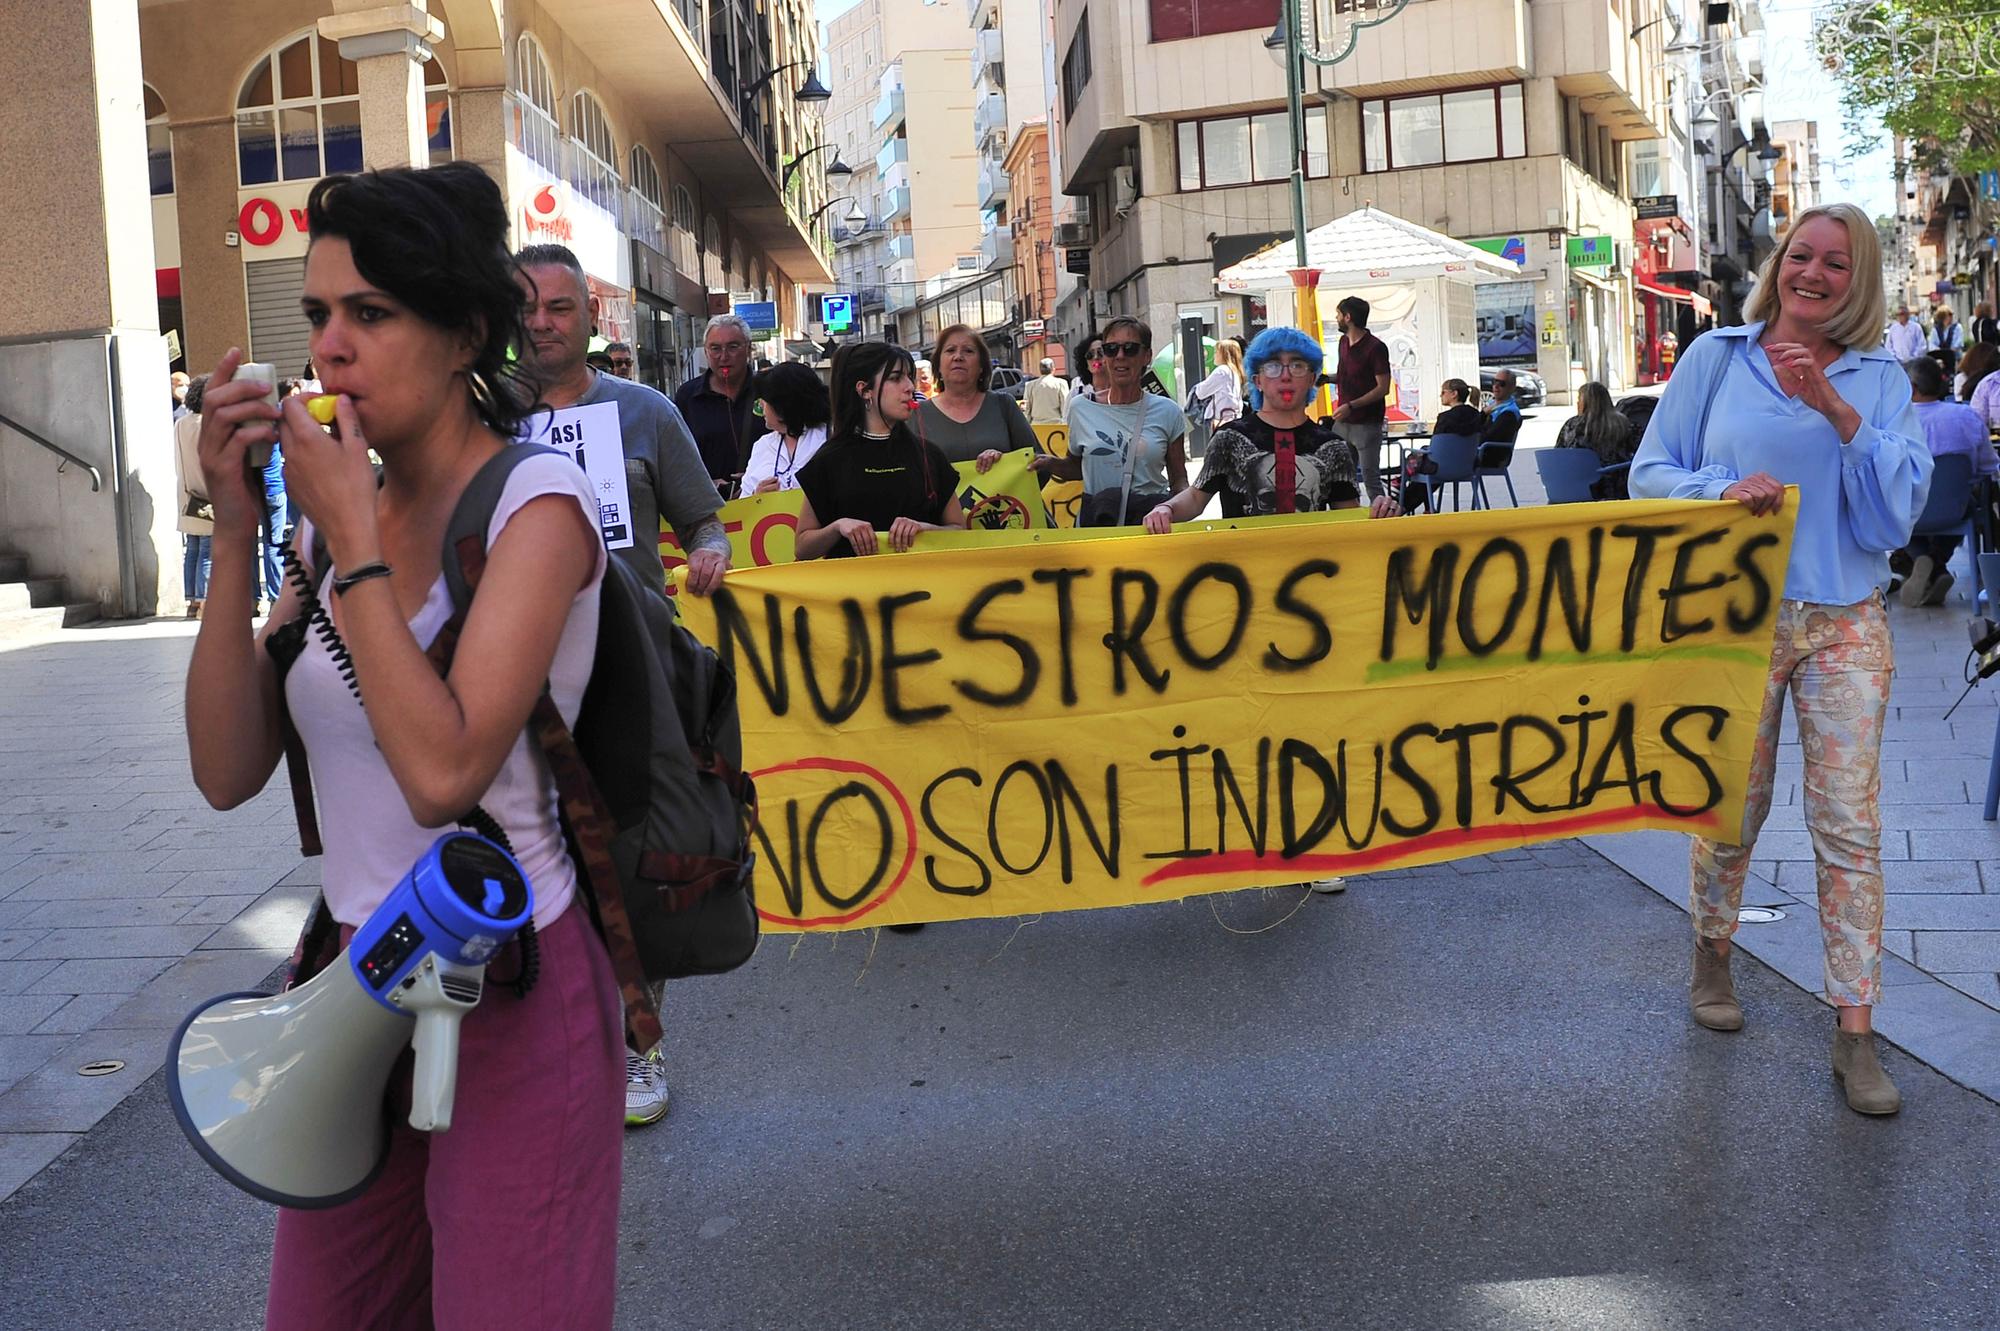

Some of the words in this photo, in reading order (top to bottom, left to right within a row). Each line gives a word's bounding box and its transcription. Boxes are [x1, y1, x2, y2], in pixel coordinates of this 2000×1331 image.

[829, 298, 845, 320] P
[551, 419, 583, 445] ASÍ
[712, 558, 1339, 725] NUESTROS
[1379, 524, 1781, 670] MONTES
[919, 758, 1121, 897] SON
